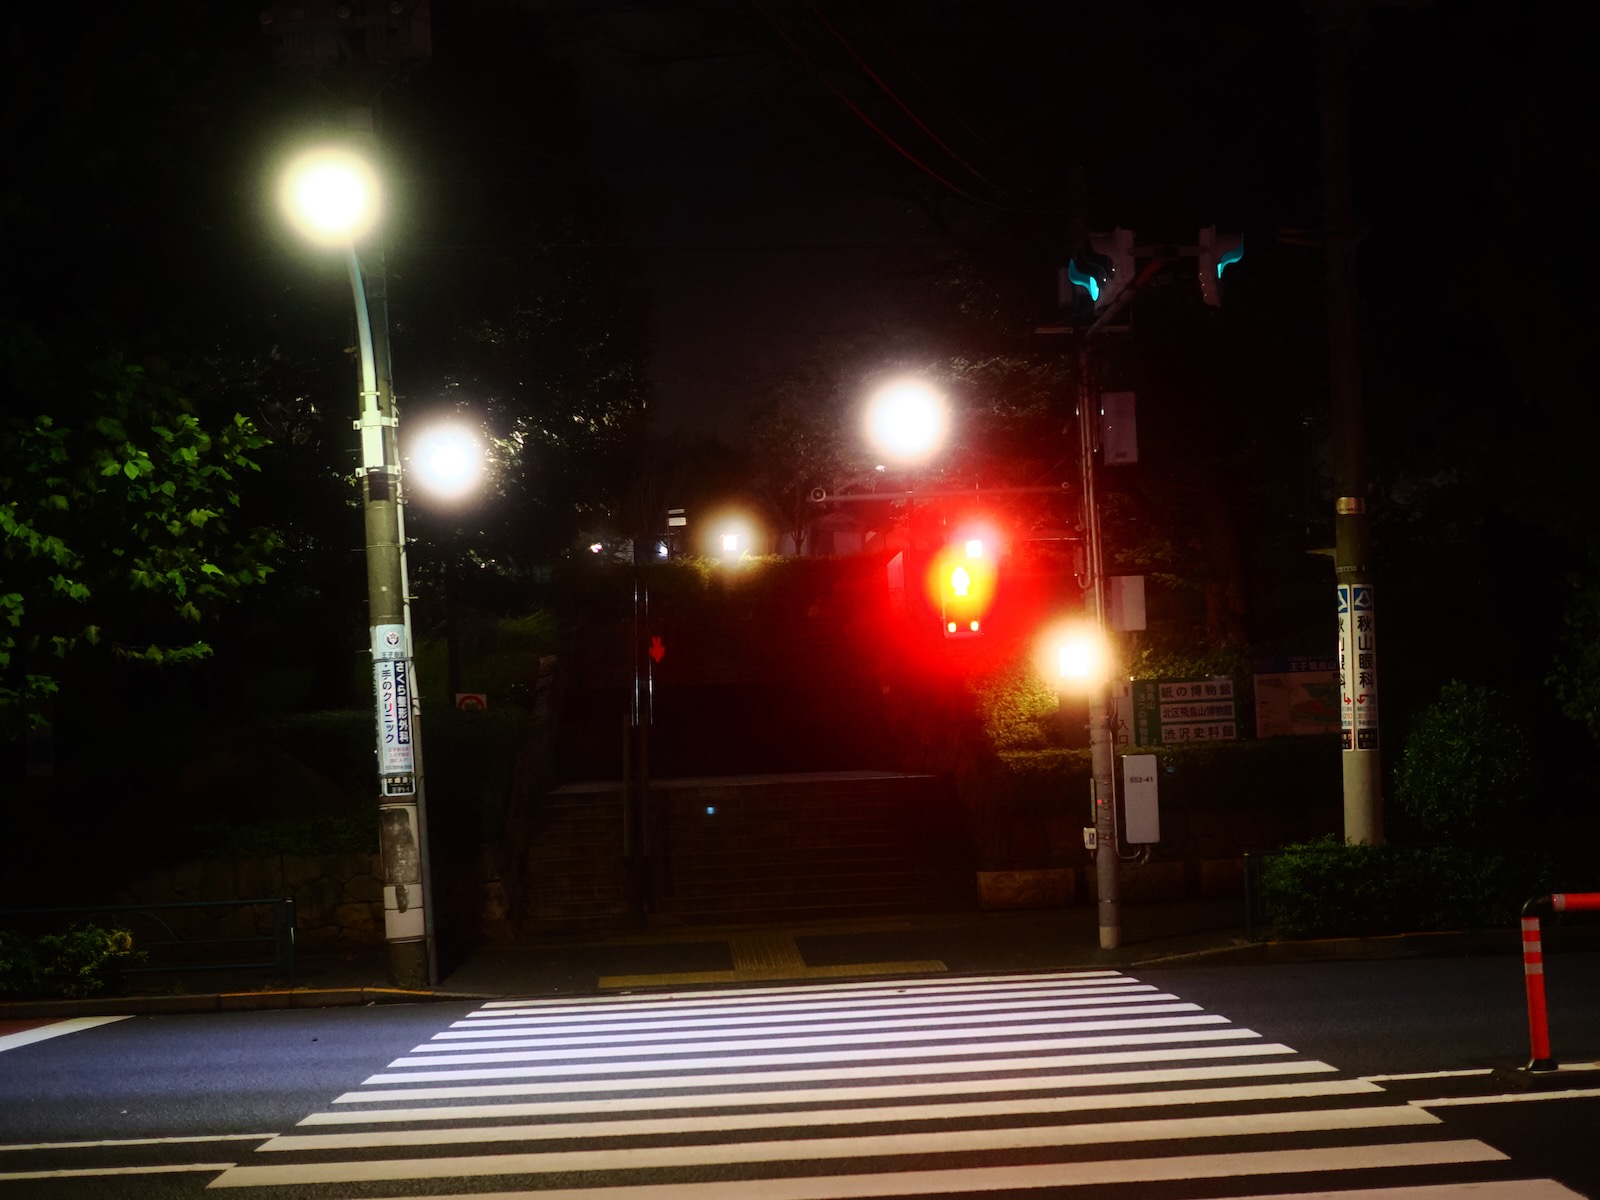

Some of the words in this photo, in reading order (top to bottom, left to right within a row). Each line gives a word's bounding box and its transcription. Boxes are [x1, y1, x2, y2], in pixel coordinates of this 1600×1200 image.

[1357, 615, 1374, 690] 秋山眼科
[1161, 683, 1231, 698] 紙の博物館
[395, 661, 410, 743] さくら整形外科
[1162, 704, 1233, 719] 北区飛鳥山博物館
[1163, 724, 1235, 740] 渋沢史料館
[1129, 776, 1153, 784] 552-41
